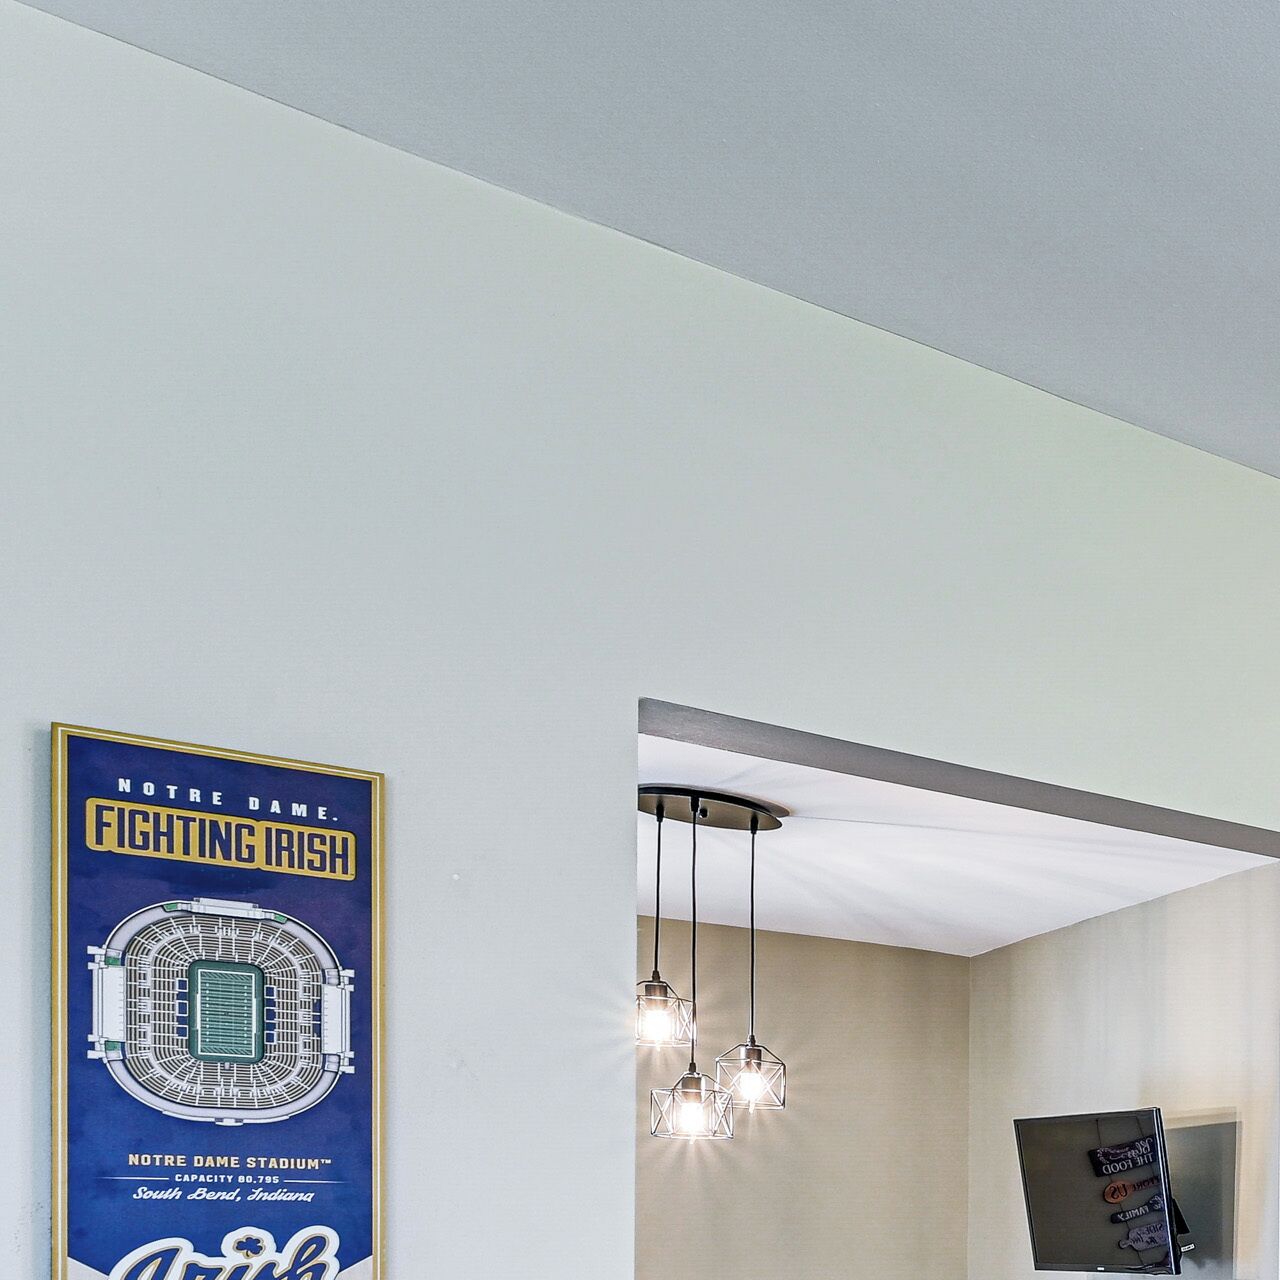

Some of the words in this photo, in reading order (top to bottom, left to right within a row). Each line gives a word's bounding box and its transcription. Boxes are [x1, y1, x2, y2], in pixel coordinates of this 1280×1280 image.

[117, 777, 223, 806] NOTRE
[94, 804, 256, 864] FIGHTING
[264, 826, 350, 876] IRISH
[128, 1153, 187, 1167] NOTRE
[193, 1155, 240, 1168] DAME
[174, 1173, 234, 1183] CAPACITY
[132, 1186, 183, 1200] South
[187, 1187, 241, 1202] Bend,
[246, 1187, 316, 1203] Indiana
